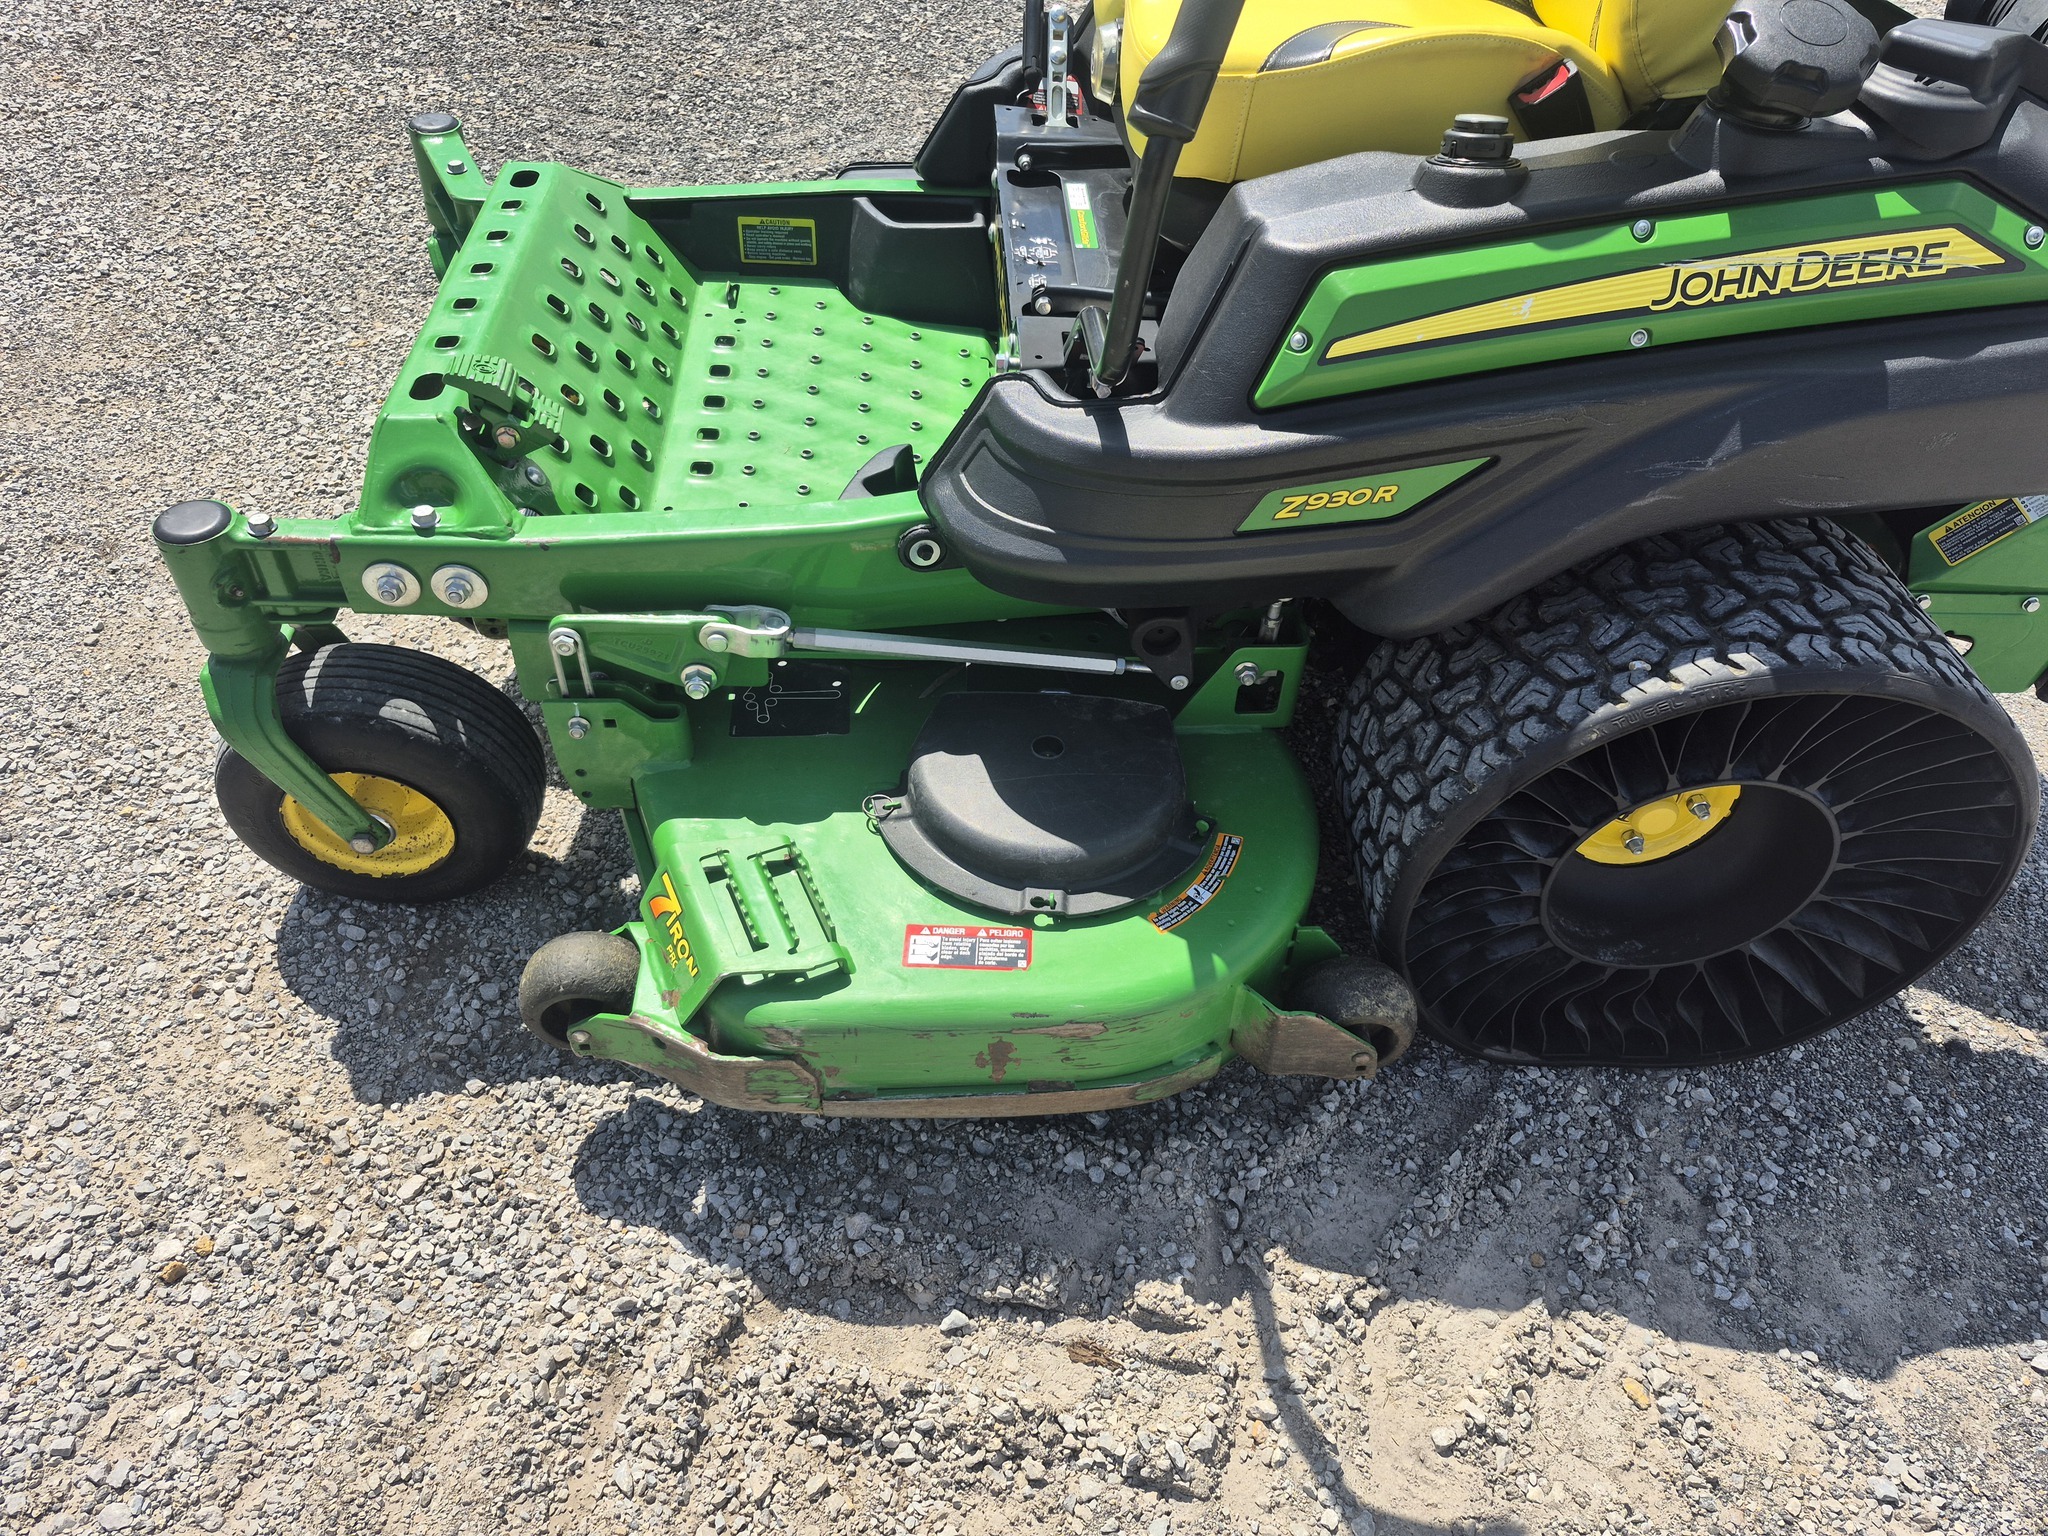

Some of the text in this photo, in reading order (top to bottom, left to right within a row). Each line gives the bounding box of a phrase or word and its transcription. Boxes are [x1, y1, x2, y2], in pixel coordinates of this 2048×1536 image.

[1651, 241, 1950, 307] JOHN DEERE
[1273, 485, 1399, 520] Z930R
[1953, 500, 1997, 528] ATENCION
[1611, 699, 1686, 729] TWEEL
[932, 927, 966, 935] DANGER
[989, 929, 1023, 937] PELIGRO
